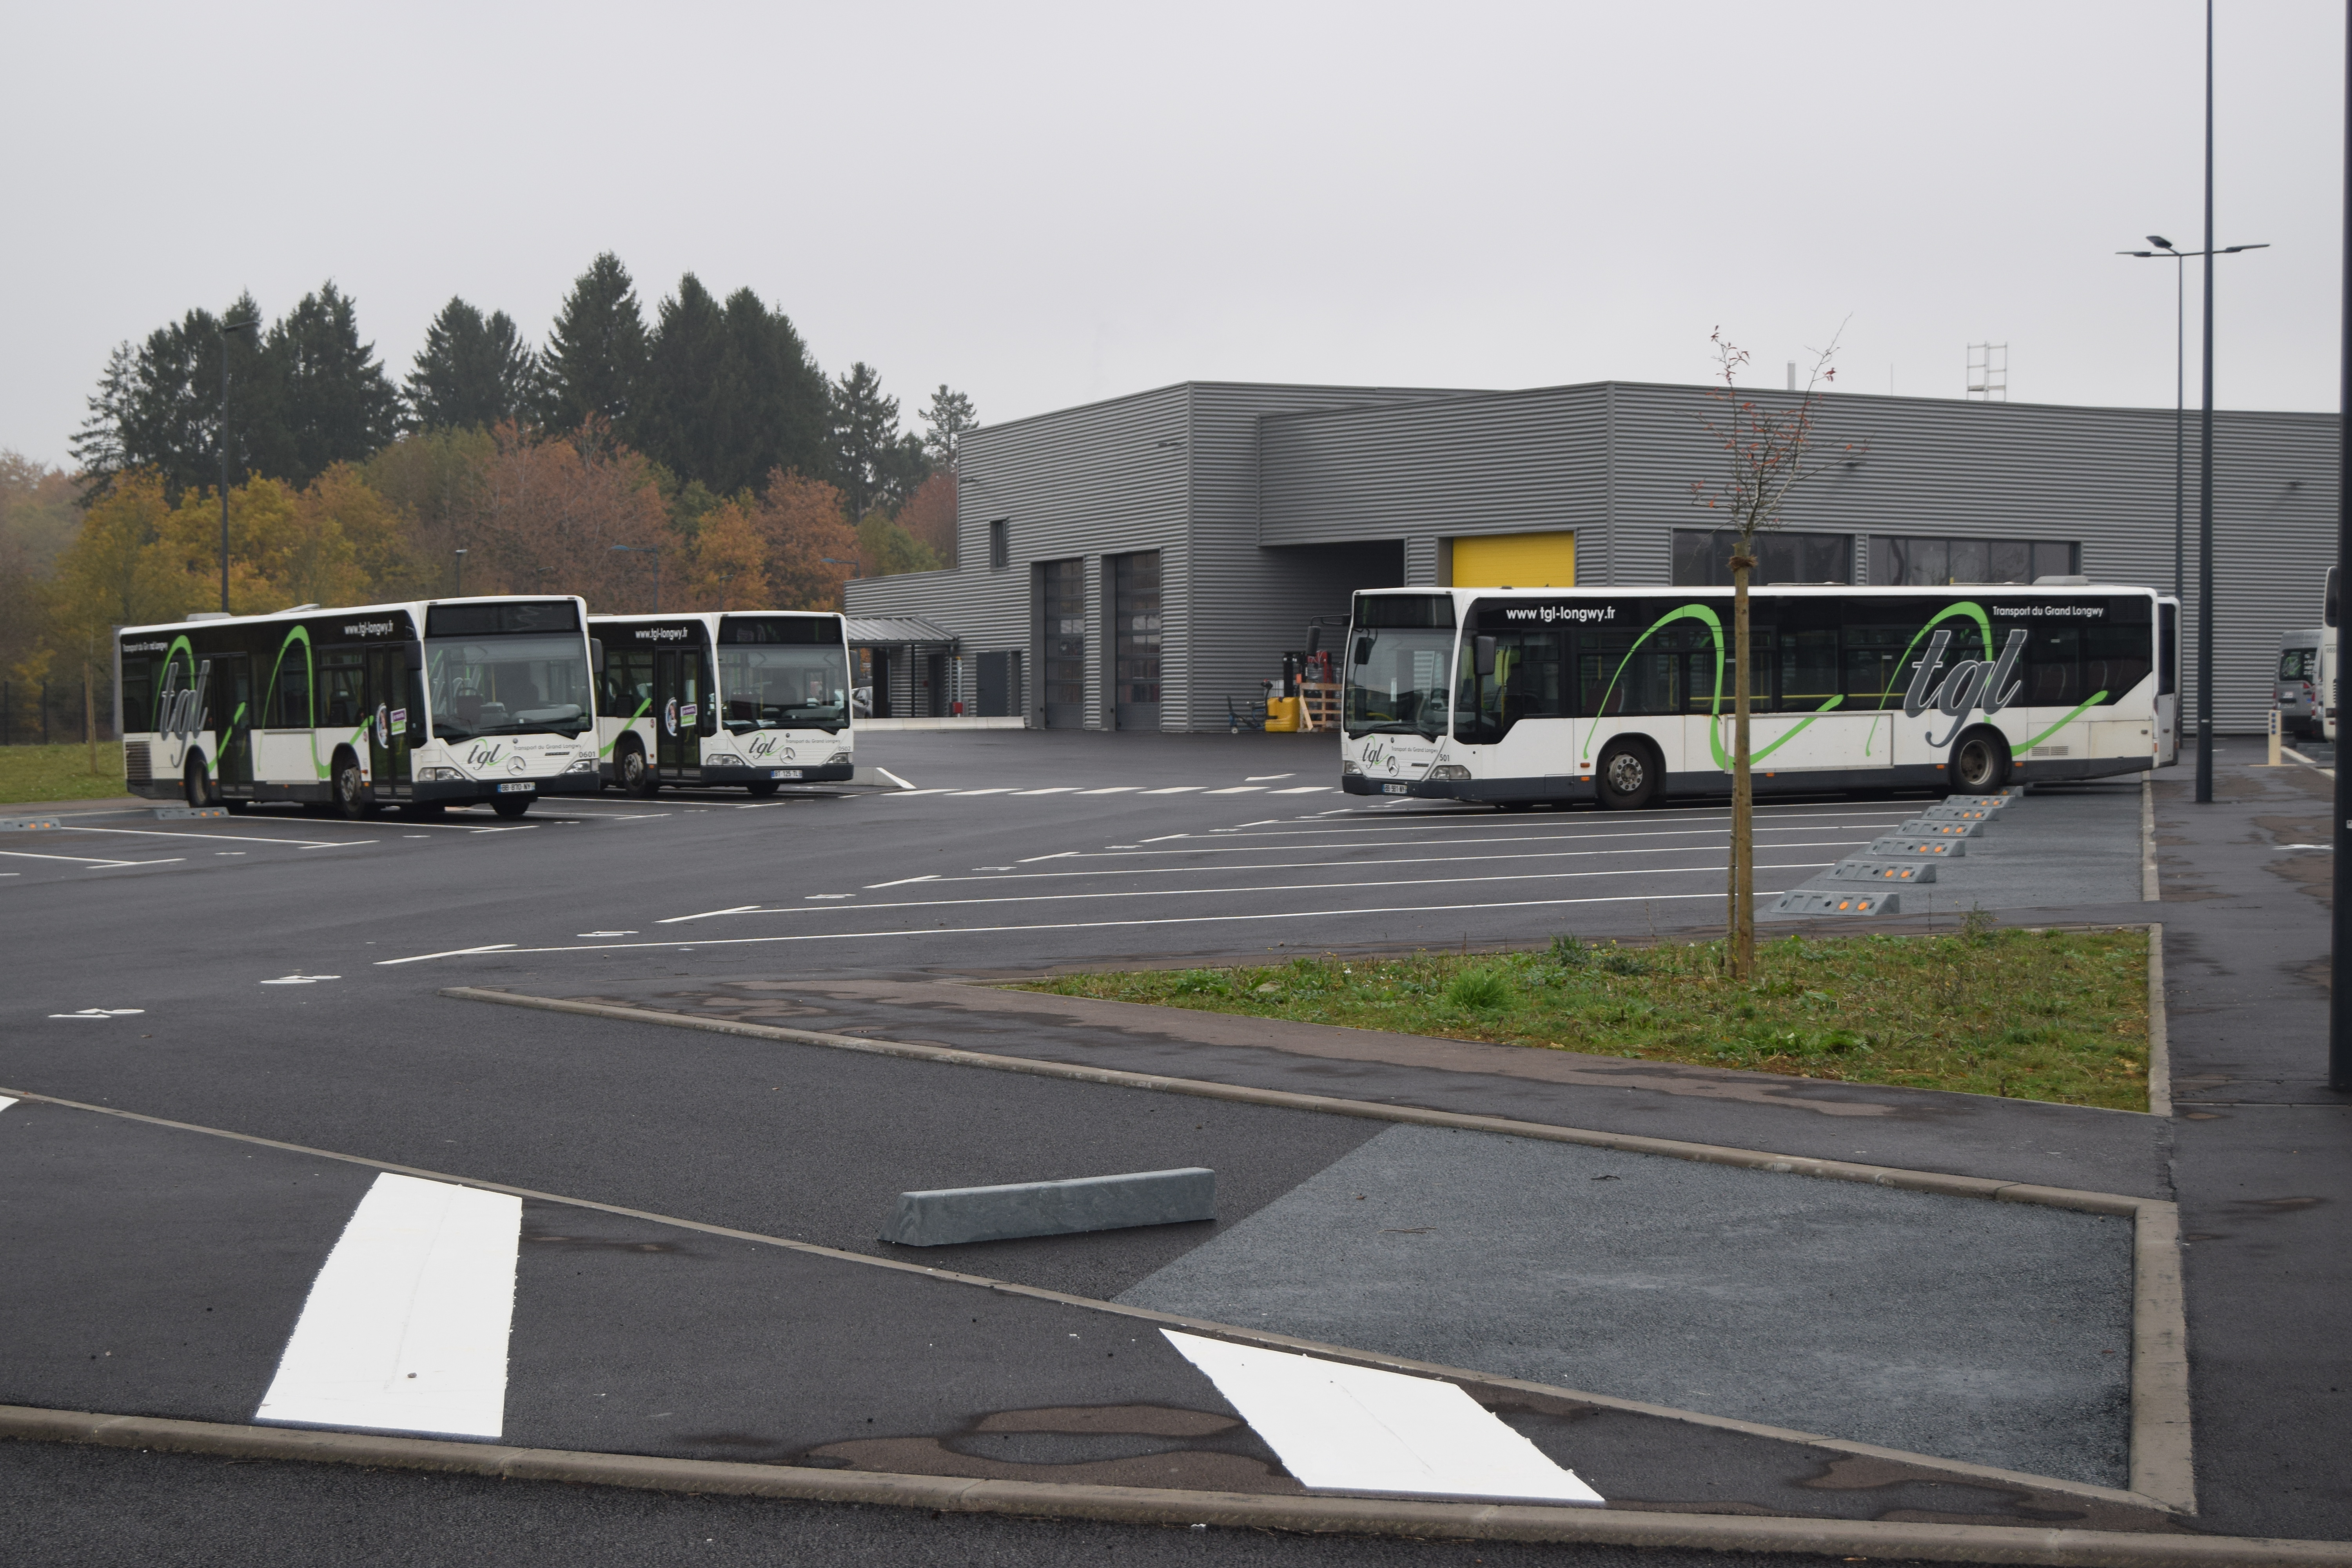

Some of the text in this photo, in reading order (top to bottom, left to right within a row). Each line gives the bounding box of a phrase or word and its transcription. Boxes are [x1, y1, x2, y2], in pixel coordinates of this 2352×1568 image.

[1506, 606, 1615, 622] www tgl-longwy.fr
[1993, 606, 2103, 617] Transport du Grand Longwy
[345, 620, 393, 637] www.tgl-longwy.fr
[635, 627, 688, 641] www.tgl-longwy.fr
[1903, 629, 2027, 748] tgl
[160, 660, 210, 768] tgl
[467, 744, 501, 771] tgl
[748, 737, 777, 759] tgl
[1362, 742, 1384, 769] tgl
